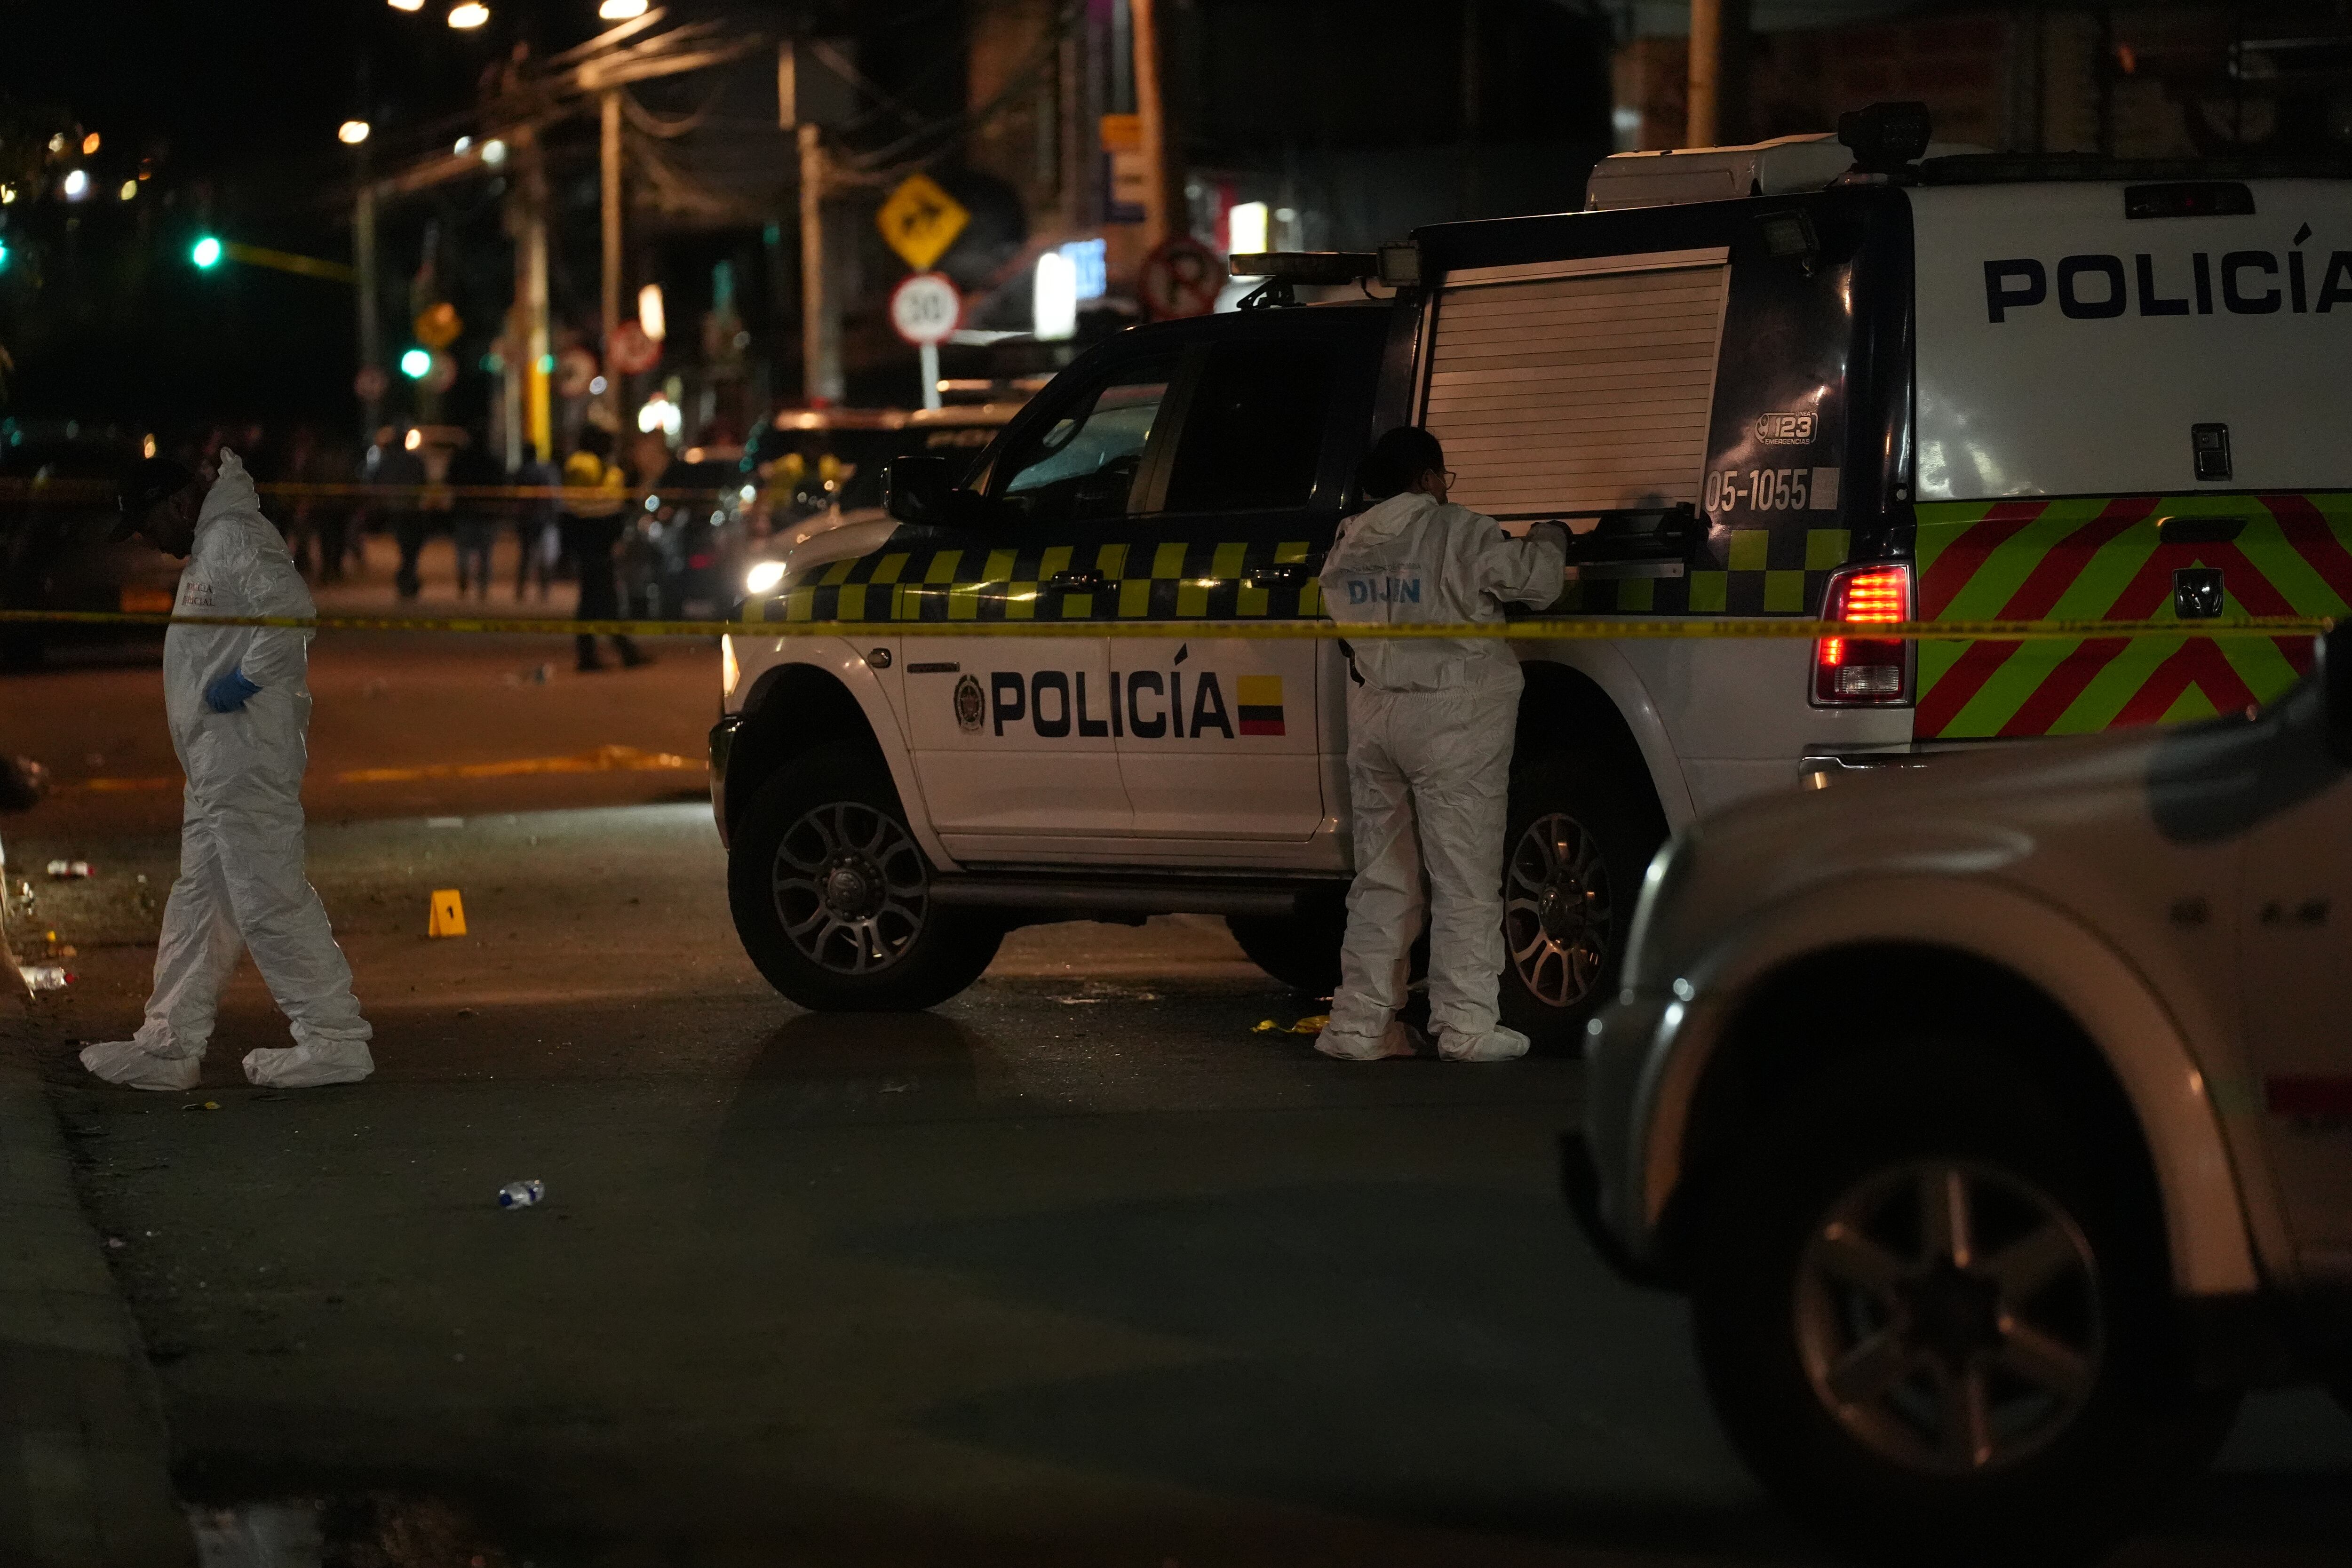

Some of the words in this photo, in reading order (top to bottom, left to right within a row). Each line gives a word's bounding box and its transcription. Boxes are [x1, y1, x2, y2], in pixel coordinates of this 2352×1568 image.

[1775, 416, 1812, 438] 123
[1705, 469, 1808, 512] 05-1055
[991, 643, 1235, 739] POLICÍA
[447, 905, 453, 919] 1
